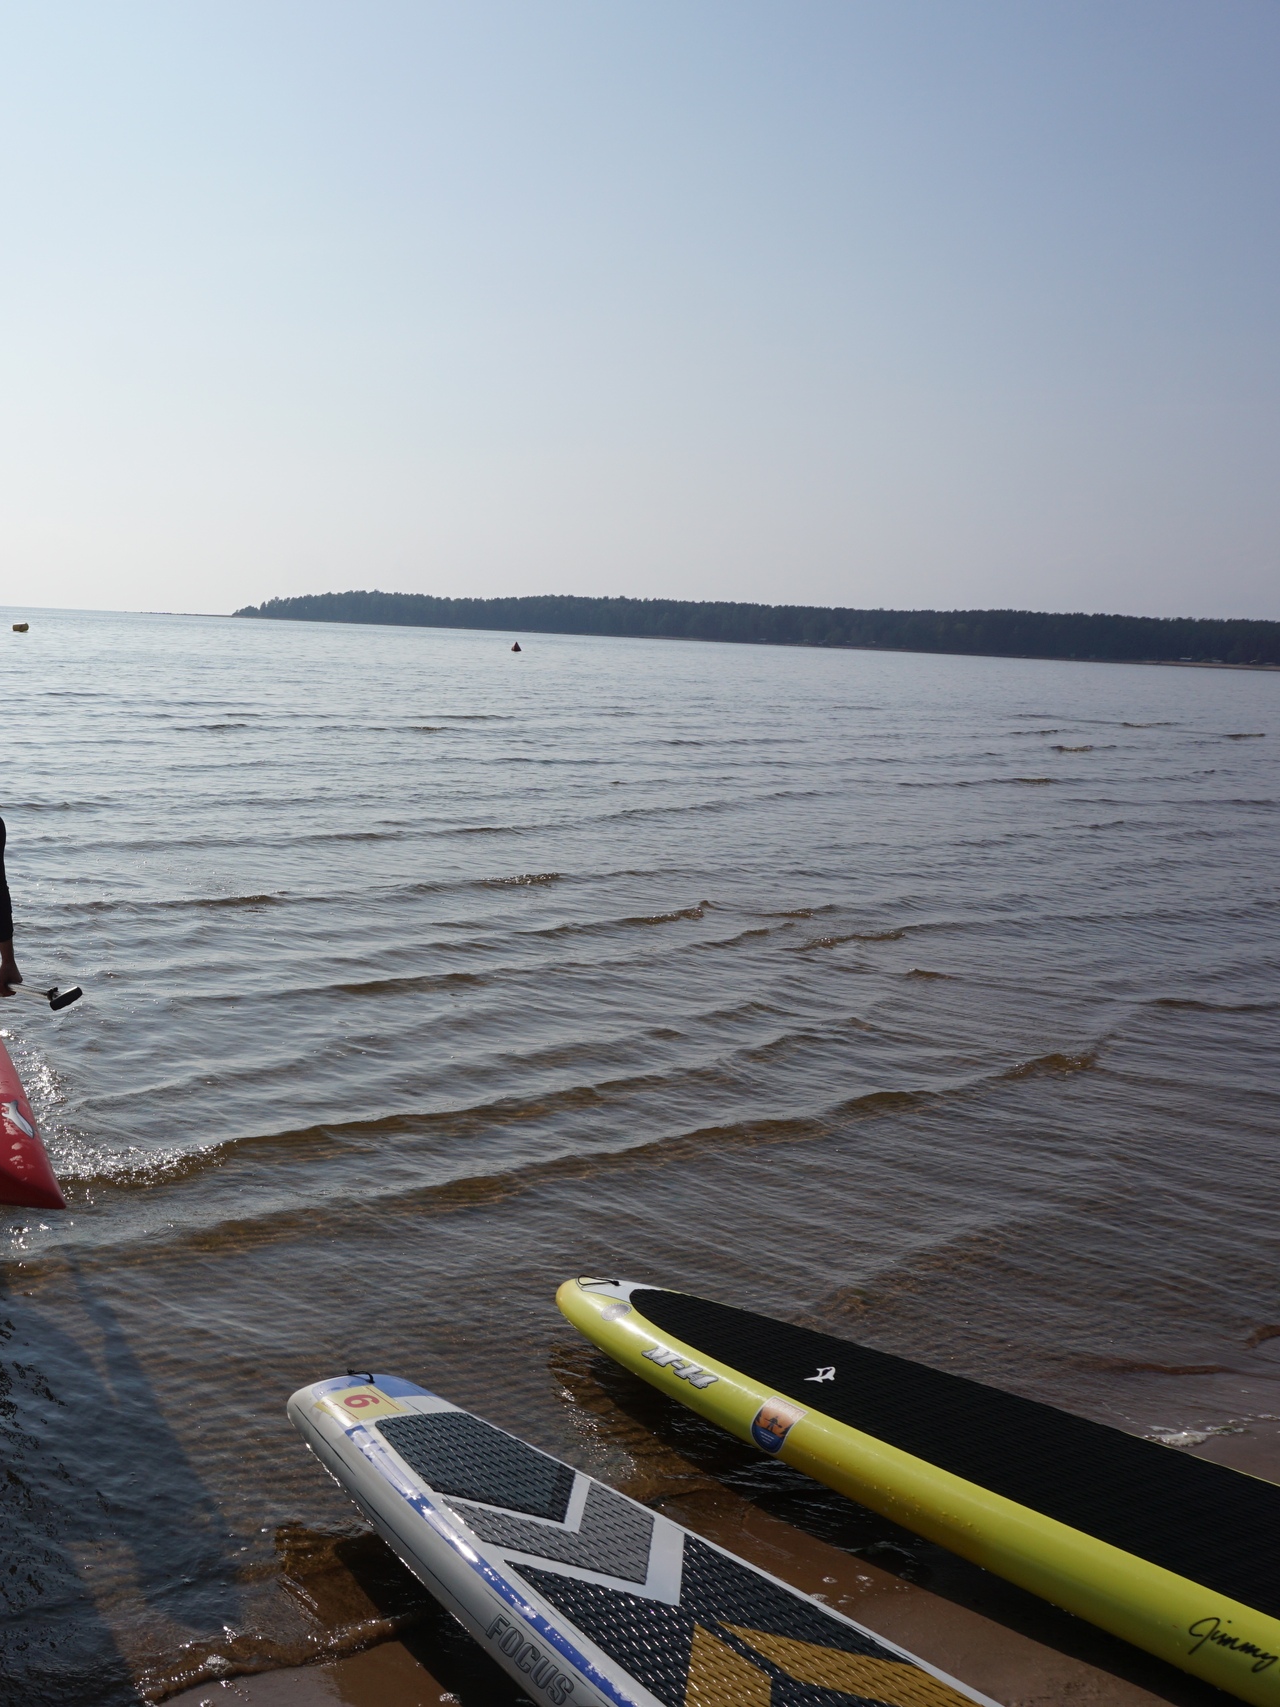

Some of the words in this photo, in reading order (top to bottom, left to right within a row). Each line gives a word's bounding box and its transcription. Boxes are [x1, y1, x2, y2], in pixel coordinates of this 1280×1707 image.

[641, 1345, 719, 1389] M-14
[485, 1613, 574, 1706] FOCUS
[1188, 1617, 1279, 1673] Jimmy
